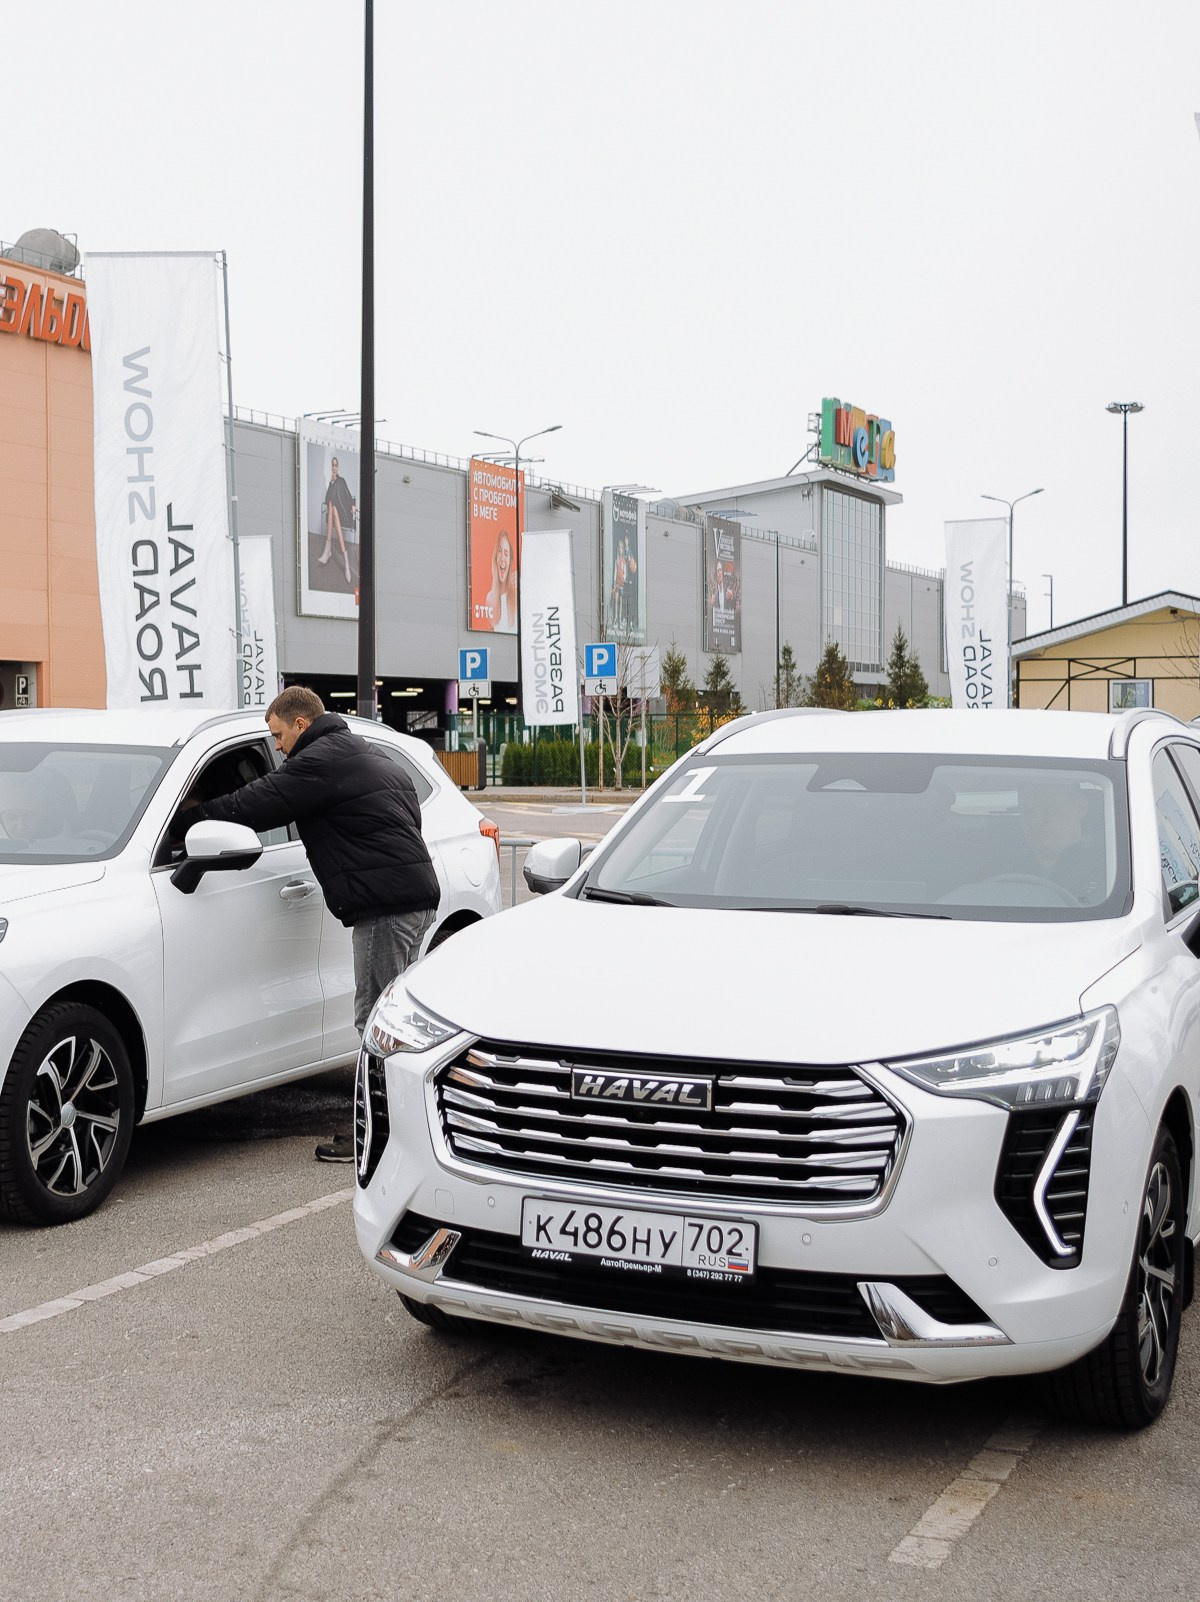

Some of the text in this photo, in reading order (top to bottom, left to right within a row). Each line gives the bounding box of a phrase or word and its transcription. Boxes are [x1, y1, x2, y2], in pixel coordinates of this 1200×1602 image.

[661, 766, 718, 803] 1
[579, 1075, 702, 1104] HAVAL
[687, 1222, 743, 1258] 702
[531, 1249, 572, 1262] HAVAL
[698, 1254, 726, 1268] RUS
[686, 1269, 692, 1277] 8
[692, 1269, 710, 1279] (347)
[724, 1273, 734, 1282] 77
[734, 1274, 743, 1283] 77
